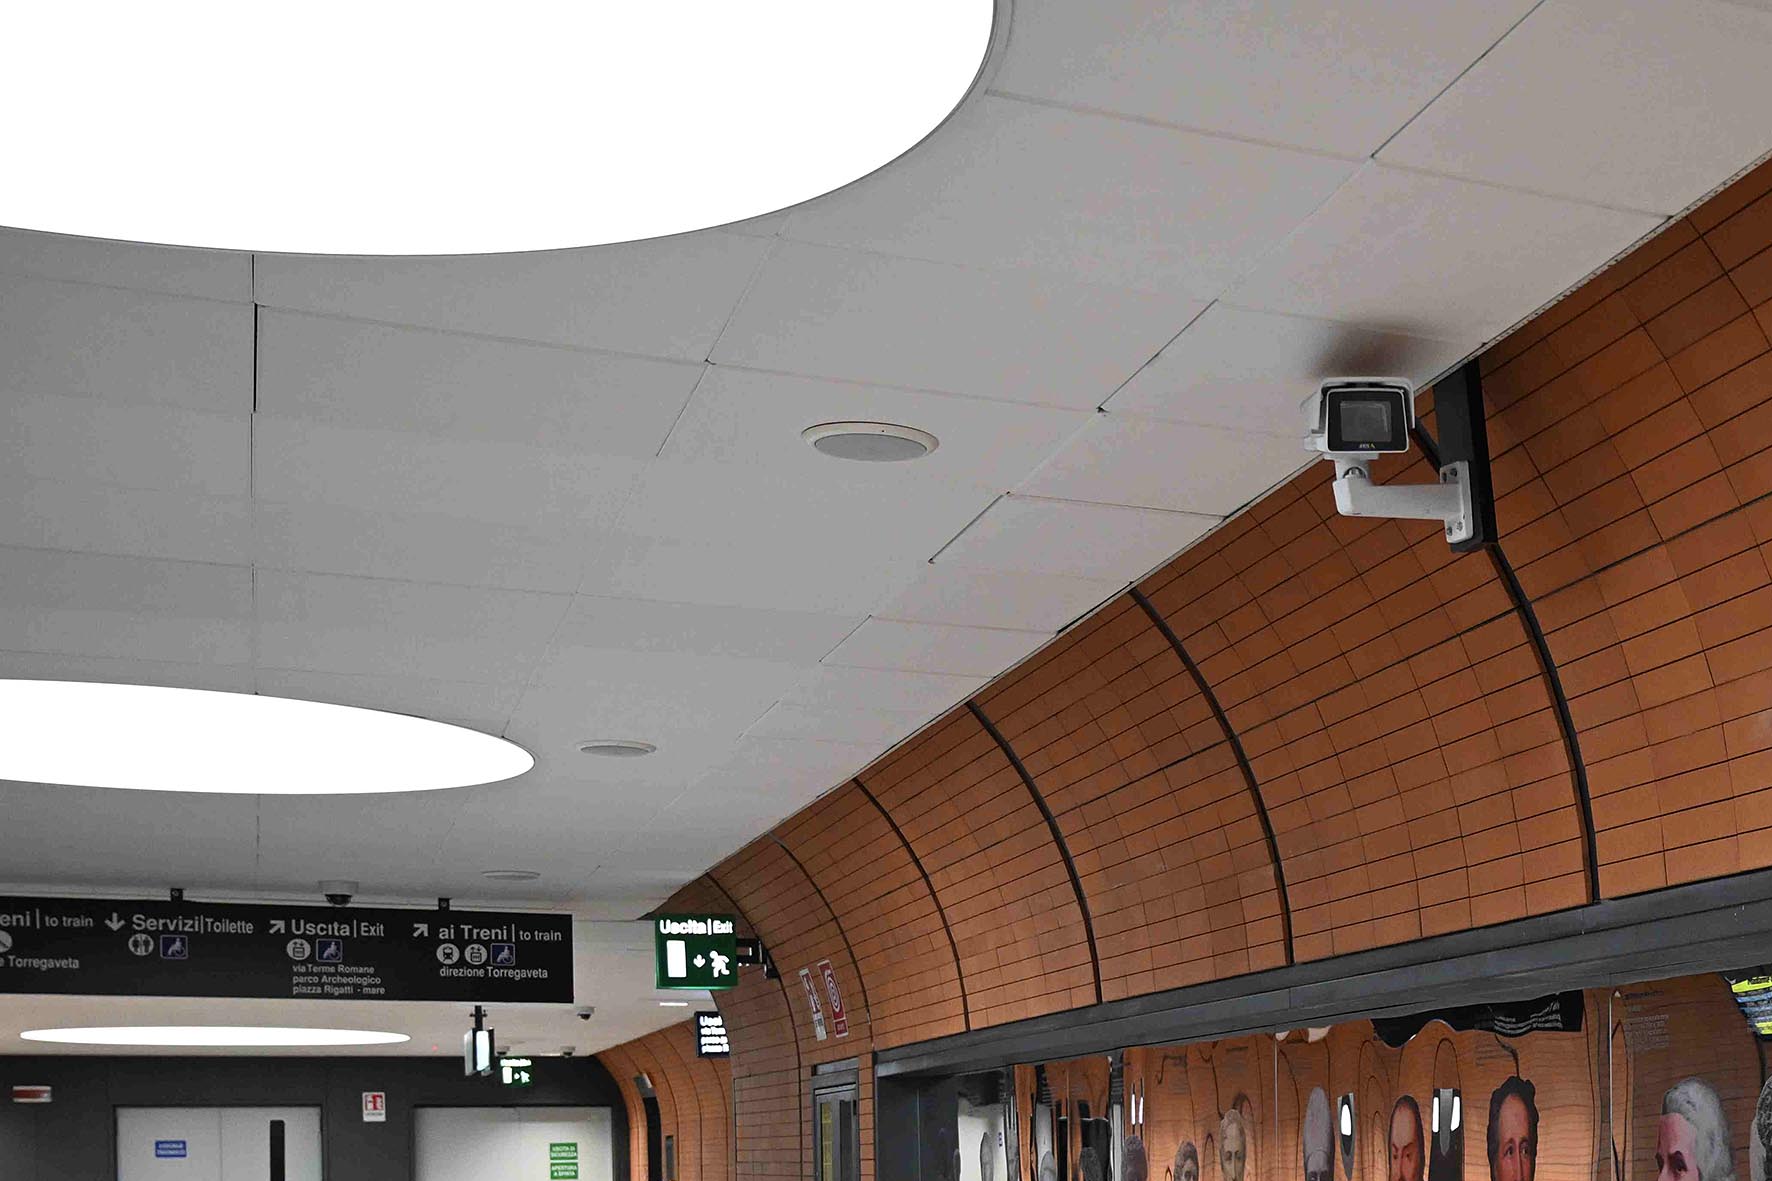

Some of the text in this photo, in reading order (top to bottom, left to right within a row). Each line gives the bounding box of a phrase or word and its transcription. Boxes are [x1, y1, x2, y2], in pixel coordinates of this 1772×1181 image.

[45, 915, 59, 927] to
[62, 914, 94, 928] train
[132, 914, 254, 934] Servizi Toilette
[291, 919, 385, 937] Uscita Exit
[660, 919, 706, 934] Uscita
[439, 925, 562, 941] ai Treni to train
[8, 955, 80, 971] Torregaveta
[292, 964, 375, 974] via Terme Romane
[439, 966, 549, 980] direzione Torregaveta
[292, 975, 382, 986] parco Archeologico
[292, 985, 322, 995] piazza
[362, 986, 386, 995] mare
